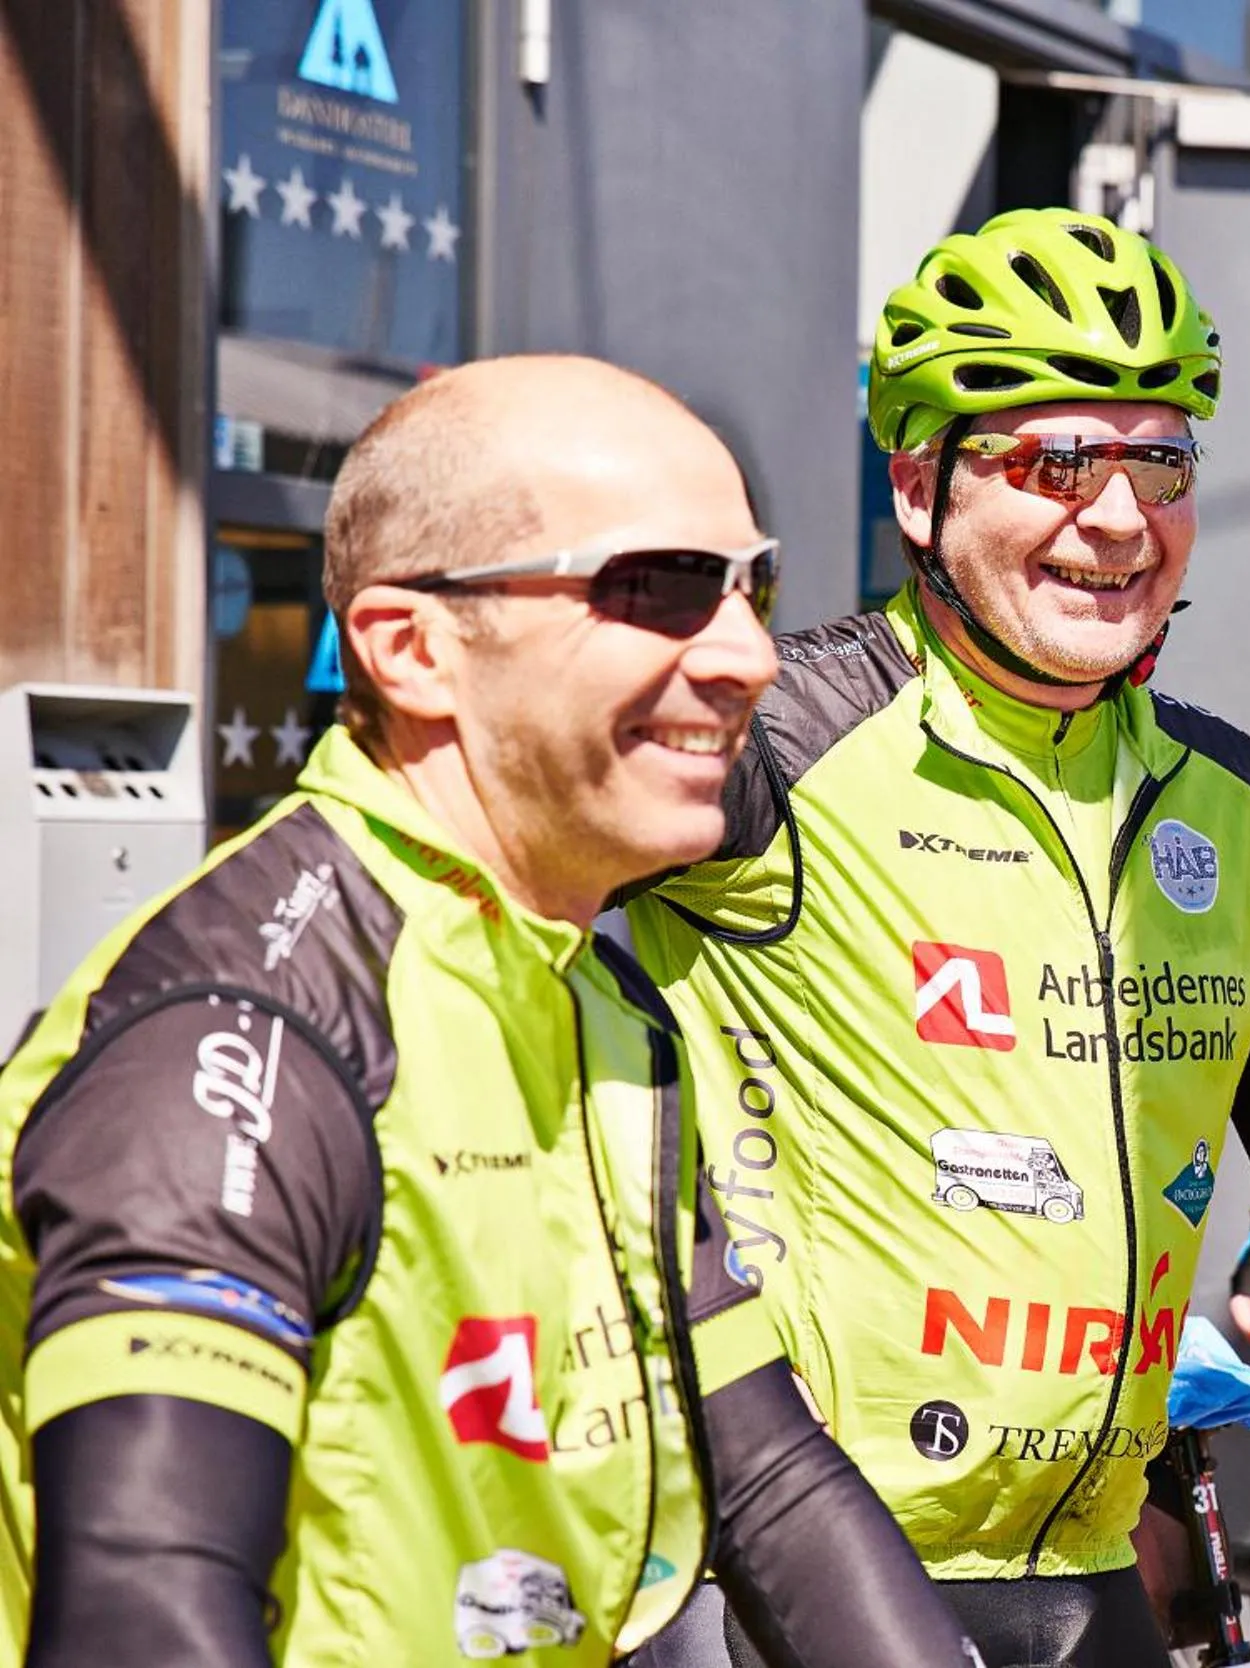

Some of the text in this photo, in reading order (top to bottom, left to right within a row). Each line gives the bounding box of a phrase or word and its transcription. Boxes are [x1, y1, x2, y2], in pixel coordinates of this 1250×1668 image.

[1038, 961, 1246, 1017] Arbejdernes
[1043, 1016, 1238, 1064] Landsbank
[921, 1251, 1191, 1377] NIRA
